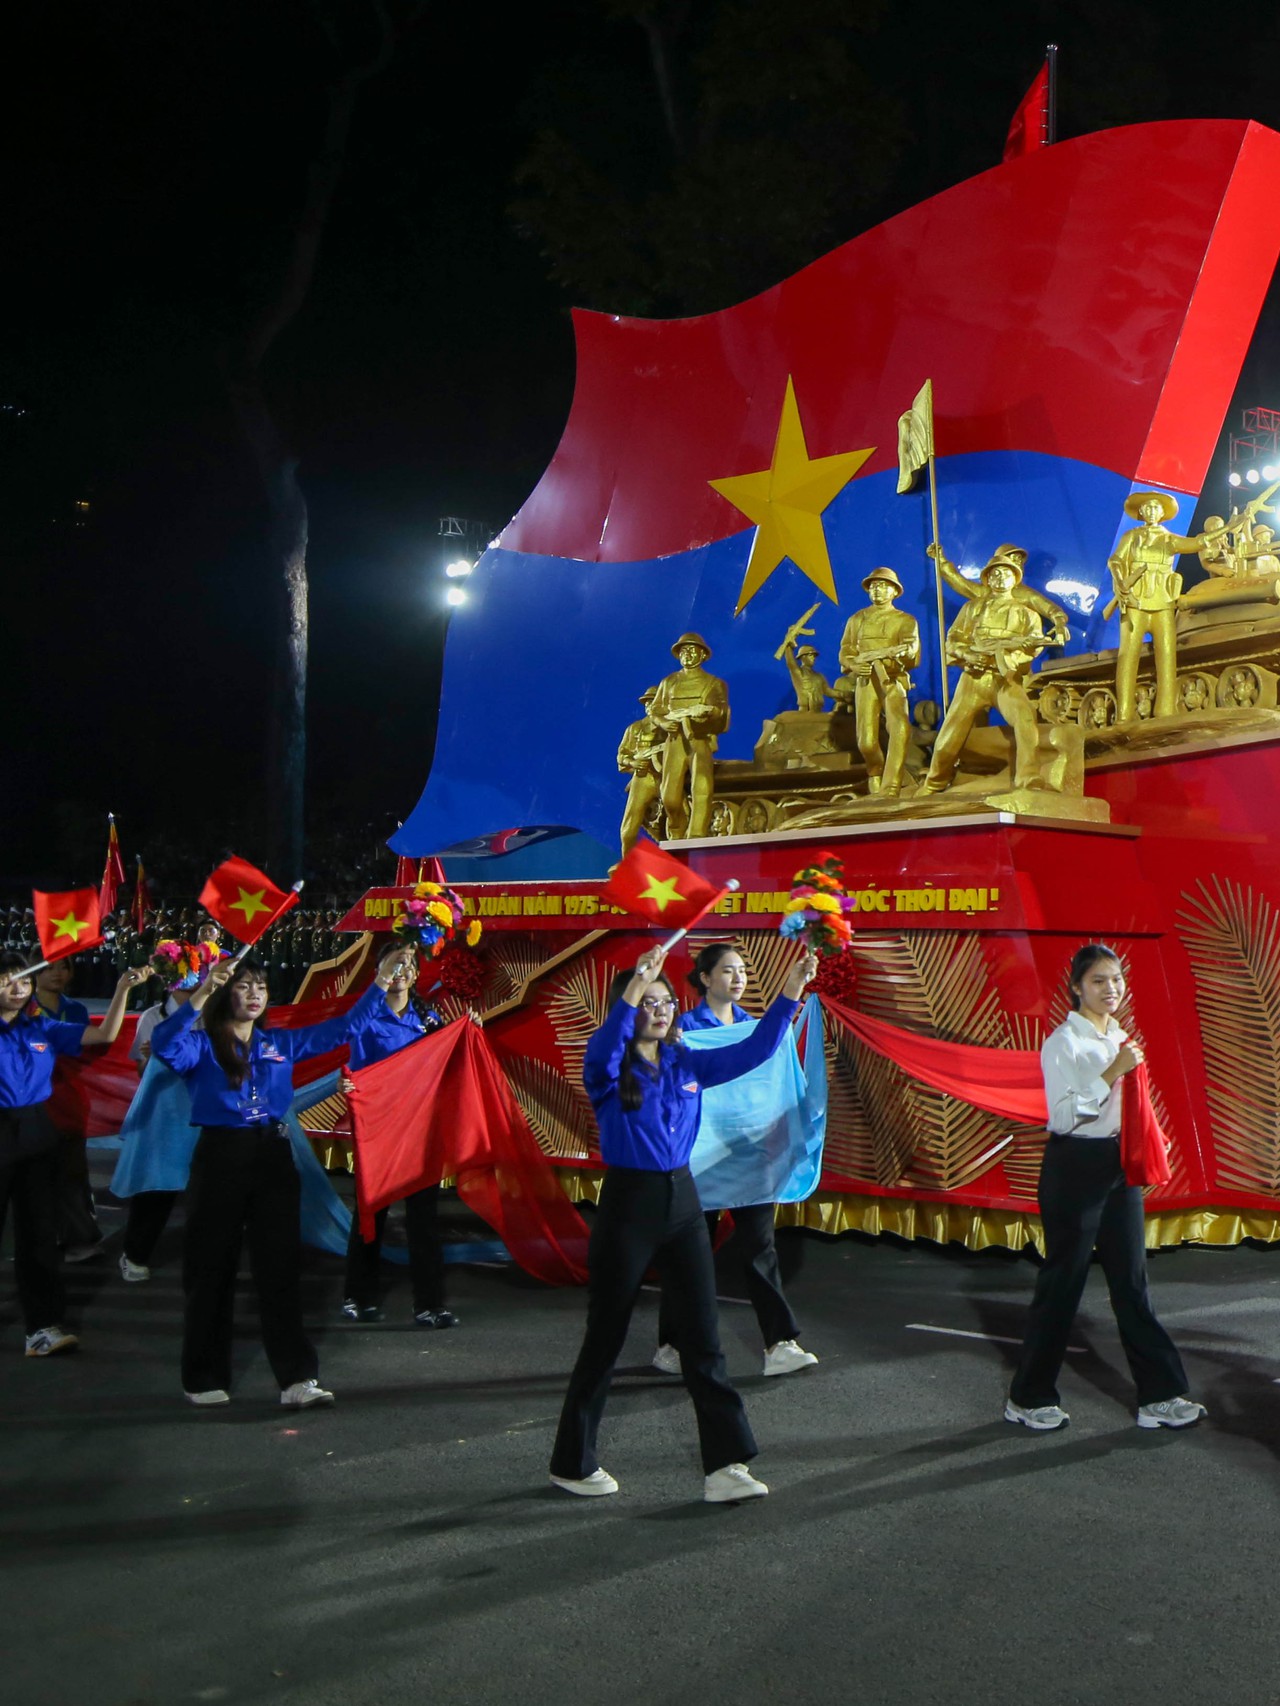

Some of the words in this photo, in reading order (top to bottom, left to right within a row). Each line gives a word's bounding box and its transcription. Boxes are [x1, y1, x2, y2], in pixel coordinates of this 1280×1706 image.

[364, 898, 391, 919] ĐẠI
[477, 892, 523, 916] XUÂN
[523, 891, 563, 916] NĂM
[564, 895, 600, 916] 1975
[893, 881, 946, 912] THỜI
[948, 888, 988, 916] ĐẠI
